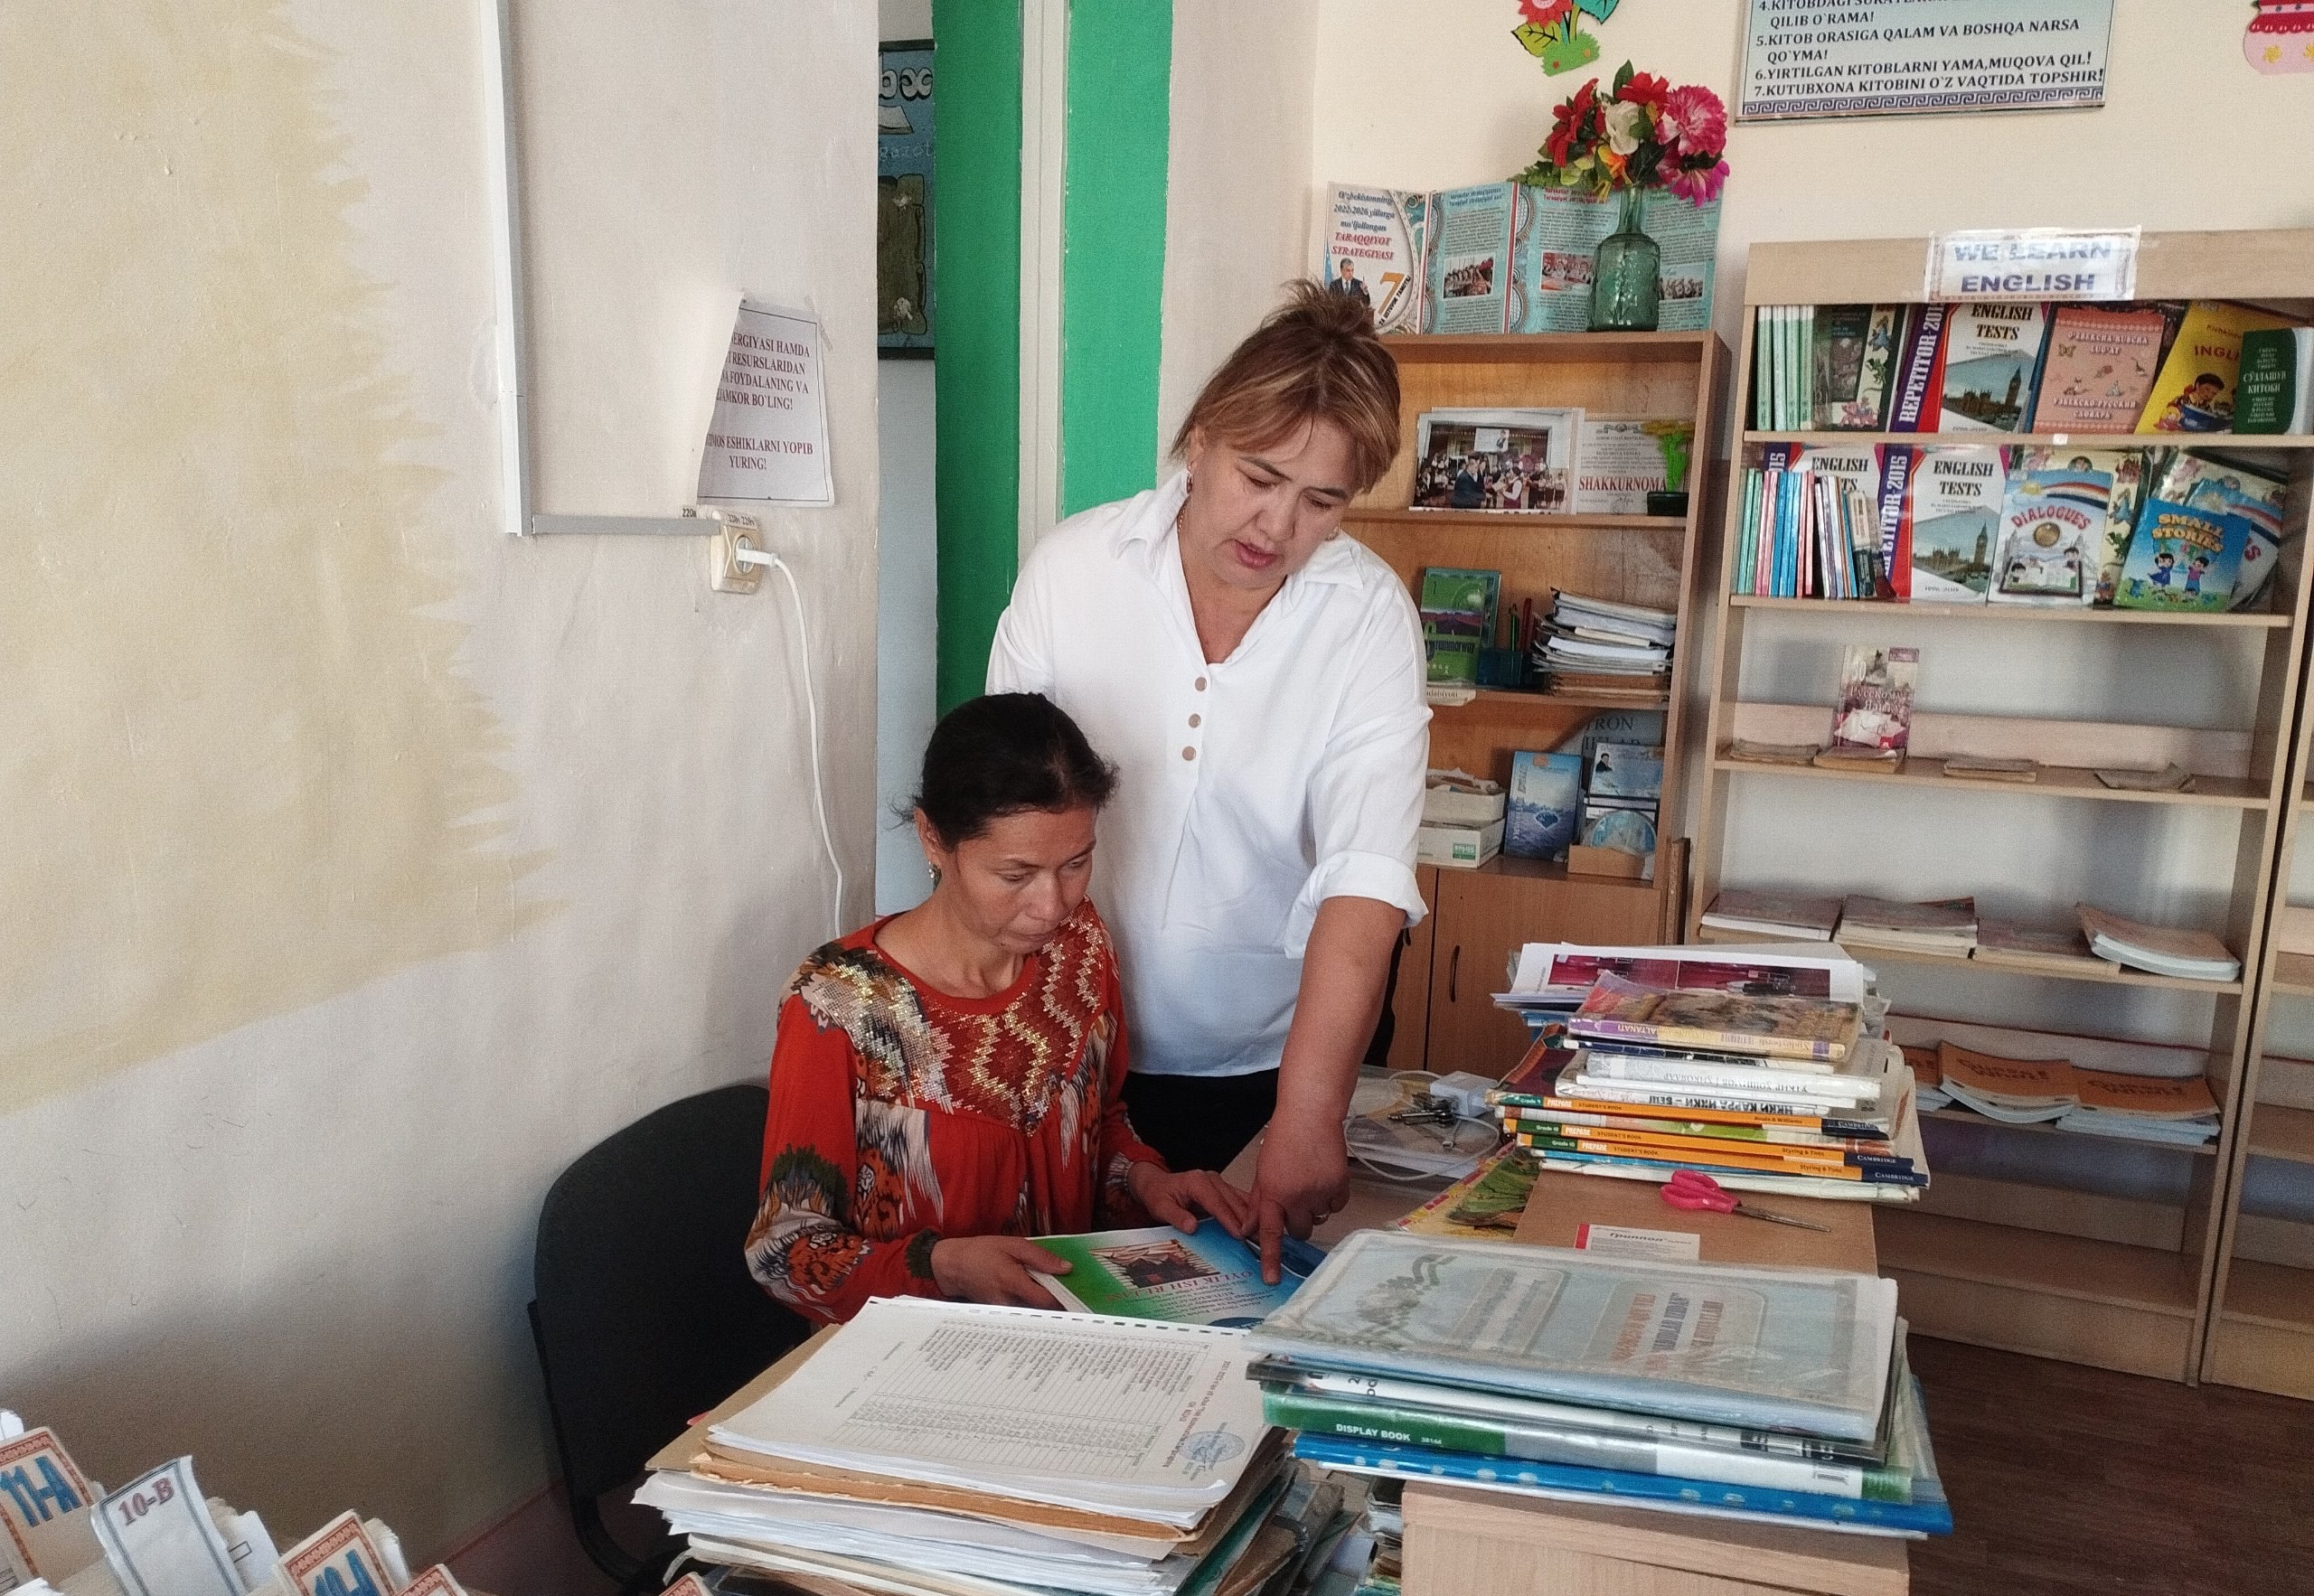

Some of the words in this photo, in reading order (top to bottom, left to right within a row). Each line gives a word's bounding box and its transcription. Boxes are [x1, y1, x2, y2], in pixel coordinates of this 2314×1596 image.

[1756, 33, 1812, 46] 5.KITOB
[1816, 29, 1879, 43] ORASIGA
[1883, 26, 1935, 42] QALAM
[1939, 25, 1959, 37] VA
[1962, 22, 2025, 36] BOSHQA
[2028, 19, 2080, 33] NARSA
[1770, 15, 1809, 30] QILIB
[1754, 65, 1844, 80] 6.YIRTILGAN
[1847, 60, 1937, 77] KITOBLARNI
[2059, 51, 2093, 67] QIL!
[1754, 81, 1854, 98] 7.KUTUBXONA
[1858, 78, 1925, 91] KITOBINI
[1957, 74, 2025, 89] VAQTIDA
[2029, 68, 2104, 85] TOPSHIR!
[1954, 243, 1999, 261] WE
[2009, 240, 2112, 260] LEARN
[1378, 271, 1405, 315] 7
[1961, 273, 2095, 294] ENGLISH
[1971, 303, 2033, 321] ENGLISH
[1977, 324, 2020, 341] TESTS
[776, 340, 810, 358] HAMDA
[732, 352, 805, 375] RESURSLARIDAN
[1899, 303, 1946, 423] REPETITOR-201
[730, 371, 794, 392] FOYDALANING
[795, 380, 809, 394] VA
[726, 436, 780, 453] ESHIKLARNI
[783, 441, 814, 455] YOPIB
[729, 455, 767, 470] YURING!
[1812, 455, 1869, 473] ENGLISH
[1934, 459, 1994, 477] ENGLISH
[1939, 480, 1982, 497] TESTS
[2010, 505, 2092, 530] DIALOGUES
[2158, 513, 2225, 539] SMALL
[2151, 527, 2225, 552] STORIES
[1547, 1099, 1573, 1108] PREPARE
[1565, 1127, 1592, 1137] PREPARE
[1857, 1154, 1897, 1164] CAMBRIDGE
[1582, 1142, 1608, 1152] PREPARE
[1875, 1171, 1914, 1181] CAMBRIDGE
[1336, 1422, 1379, 1437] DISPLAY
[1380, 1430, 1411, 1441] BOOK
